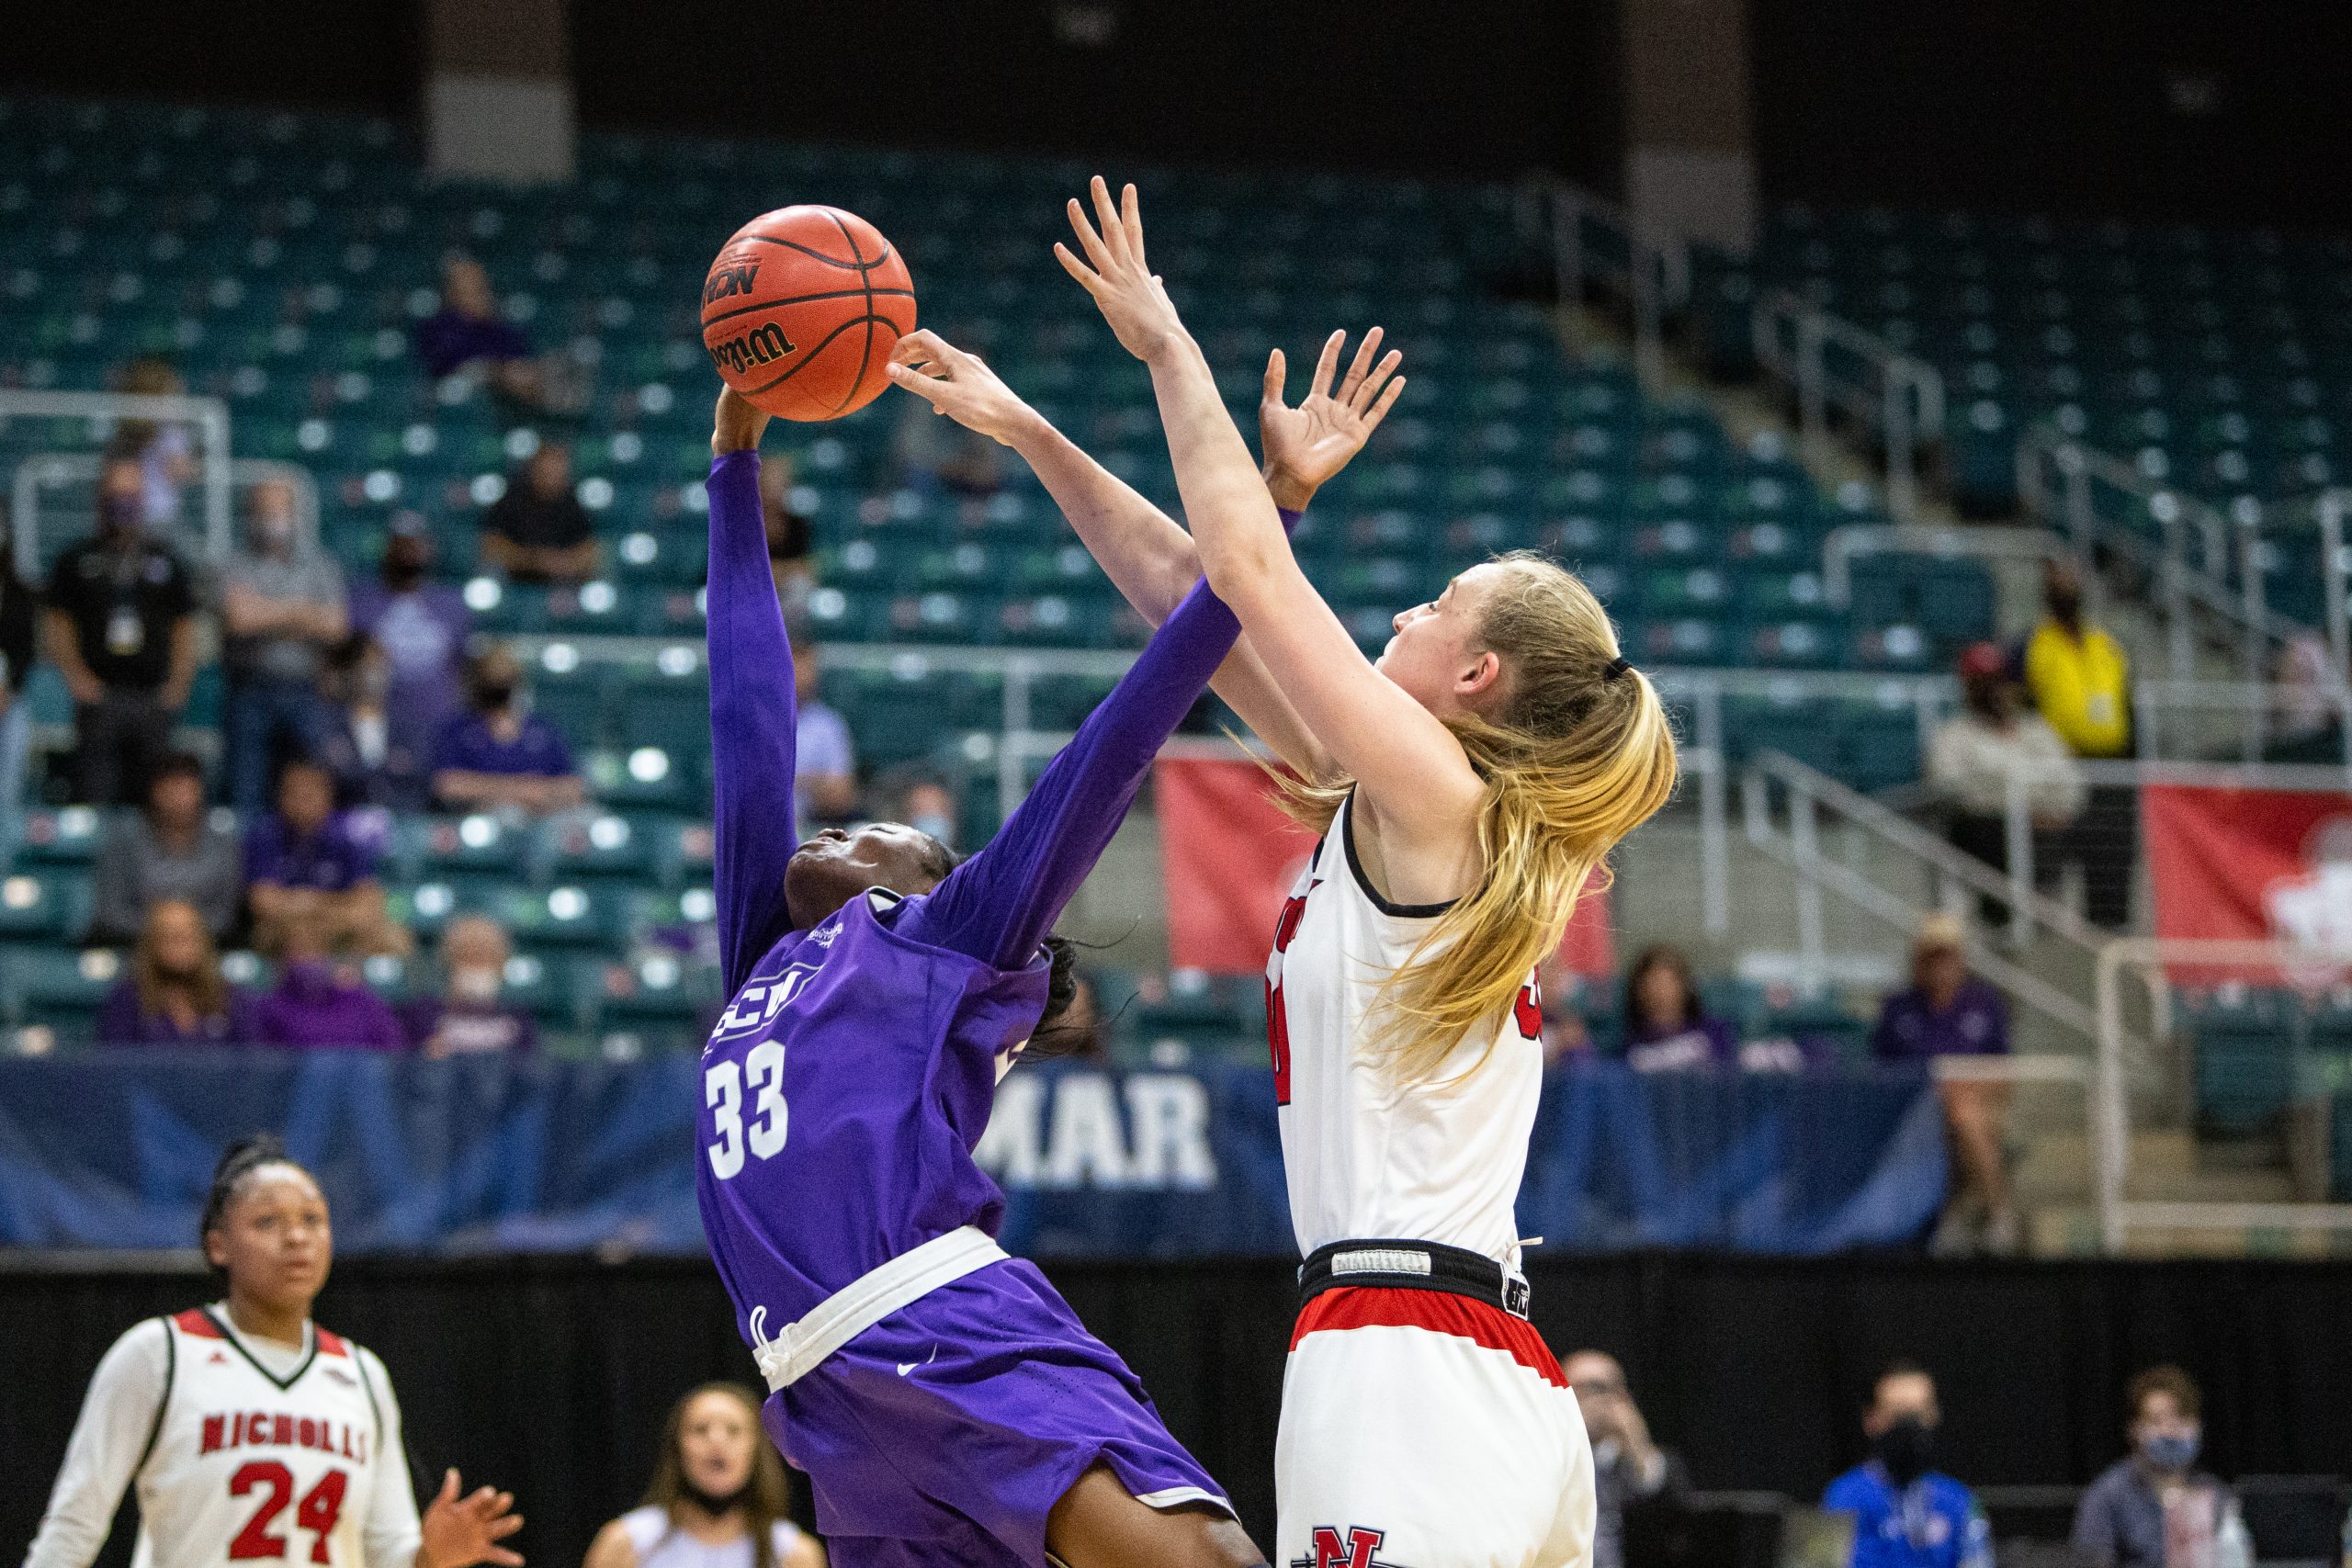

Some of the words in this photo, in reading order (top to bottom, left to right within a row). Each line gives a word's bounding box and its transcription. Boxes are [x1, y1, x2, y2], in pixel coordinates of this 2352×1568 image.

[706, 1039, 788, 1180] 33
[970, 1072, 1219, 1190] MAR
[229, 1459, 347, 1565] 24
